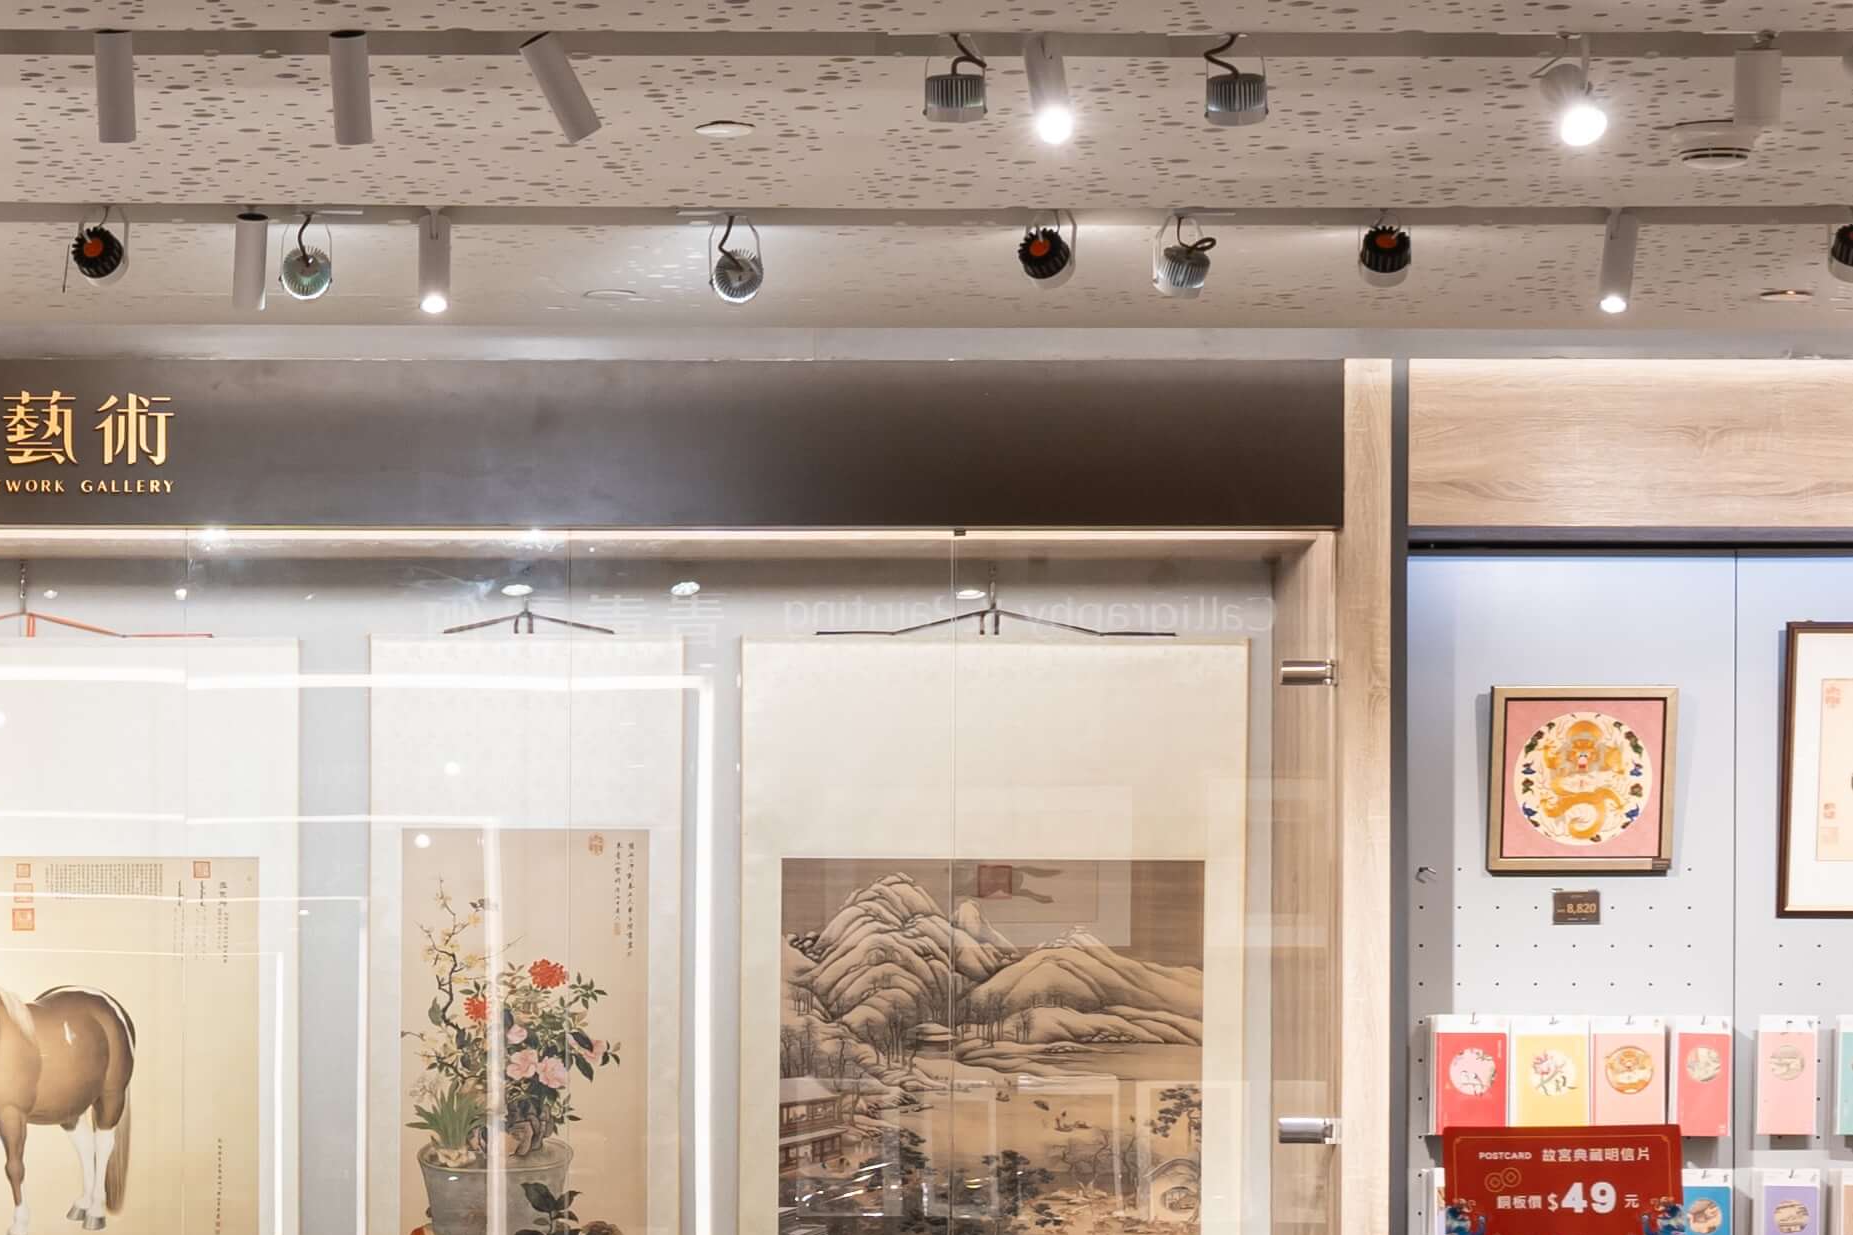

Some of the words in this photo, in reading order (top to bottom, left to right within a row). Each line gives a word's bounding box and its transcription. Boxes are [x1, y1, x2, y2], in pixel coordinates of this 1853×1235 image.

[80, 478, 177, 494] GALLERY
[1478, 1151, 1533, 1161] POSTCARD
[1541, 1147, 1651, 1163] 故宮典藏明信片
[1496, 1195, 1543, 1210] 銅板價
[1547, 1181, 1618, 1214] $49
[1624, 1193, 1640, 1209] 元
